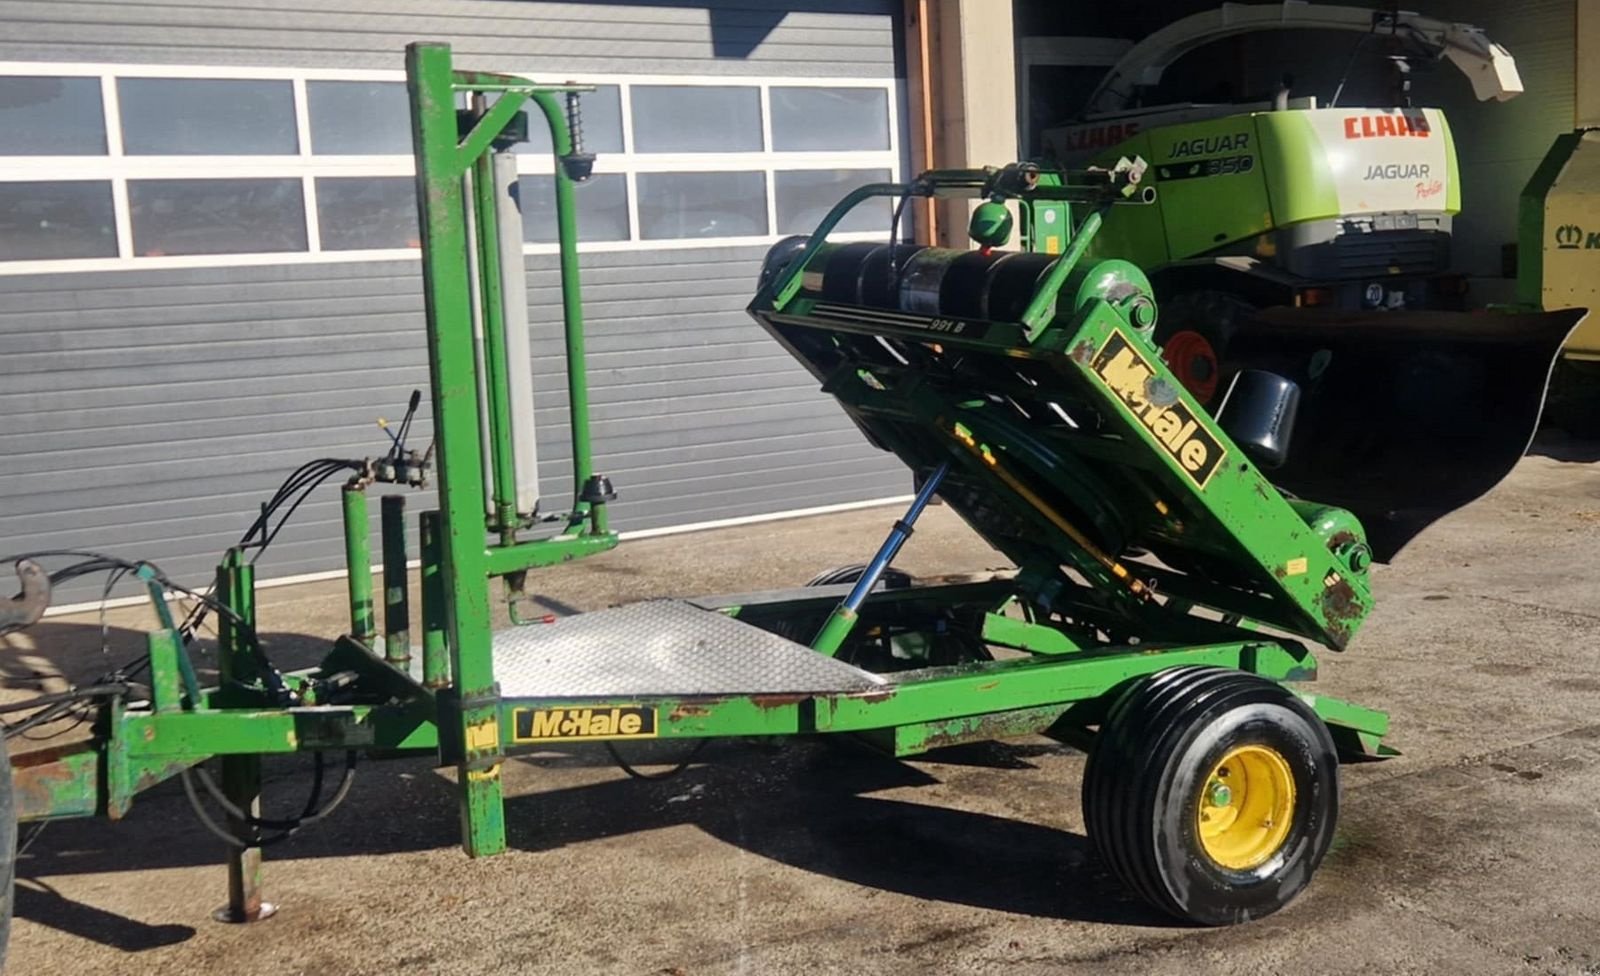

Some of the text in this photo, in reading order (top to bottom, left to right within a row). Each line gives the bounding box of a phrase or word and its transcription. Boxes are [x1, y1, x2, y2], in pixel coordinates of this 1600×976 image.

[1344, 115, 1430, 138] CLAAS
[1168, 133, 1249, 158] JAGUAR
[1363, 164, 1430, 180] JAGUAR
[930, 319, 954, 331] 991
[531, 709, 642, 737] McHale
